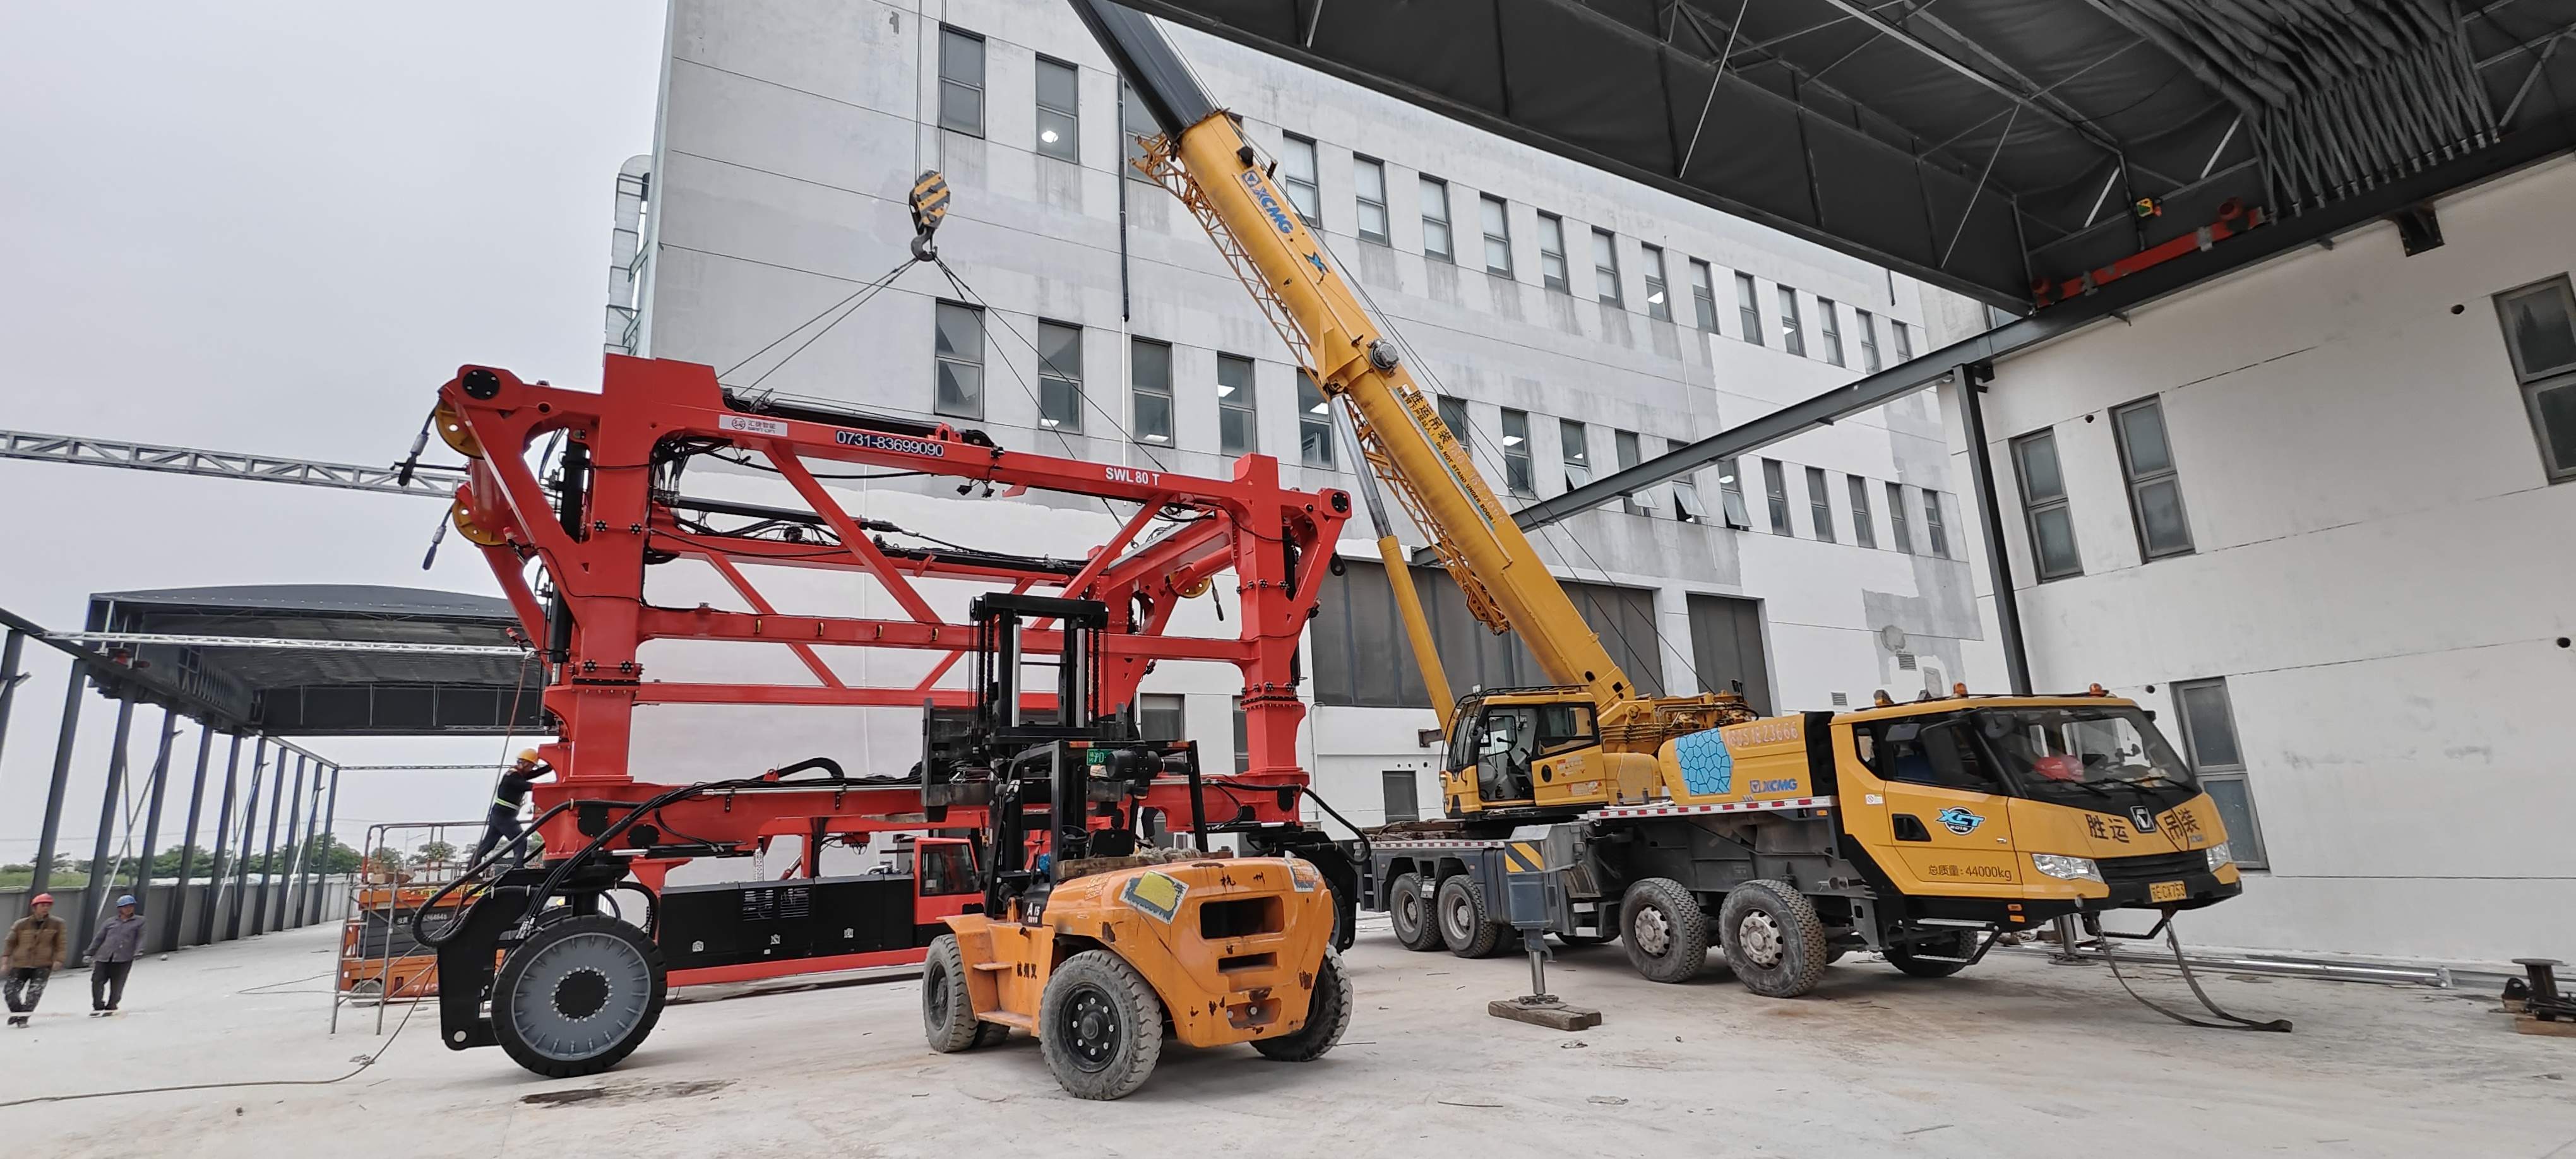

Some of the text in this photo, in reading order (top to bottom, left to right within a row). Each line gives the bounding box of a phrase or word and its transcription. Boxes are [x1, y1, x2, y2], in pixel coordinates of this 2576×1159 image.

[1253, 186, 1294, 234] XCMG
[1409, 390, 1453, 444] 胜运吊装
[837, 431, 944, 456] 0731-83699090
[1106, 467, 1160, 485] SWL 80 T
[1436, 442, 1443, 450] DO
[1443, 451, 1453, 463] NOT
[1452, 463, 1467, 483] STAND
[1465, 484, 1481, 504] UNDER
[1761, 778, 1798, 792] XCMG
[2085, 807, 2200, 843] 胜运 吊装
